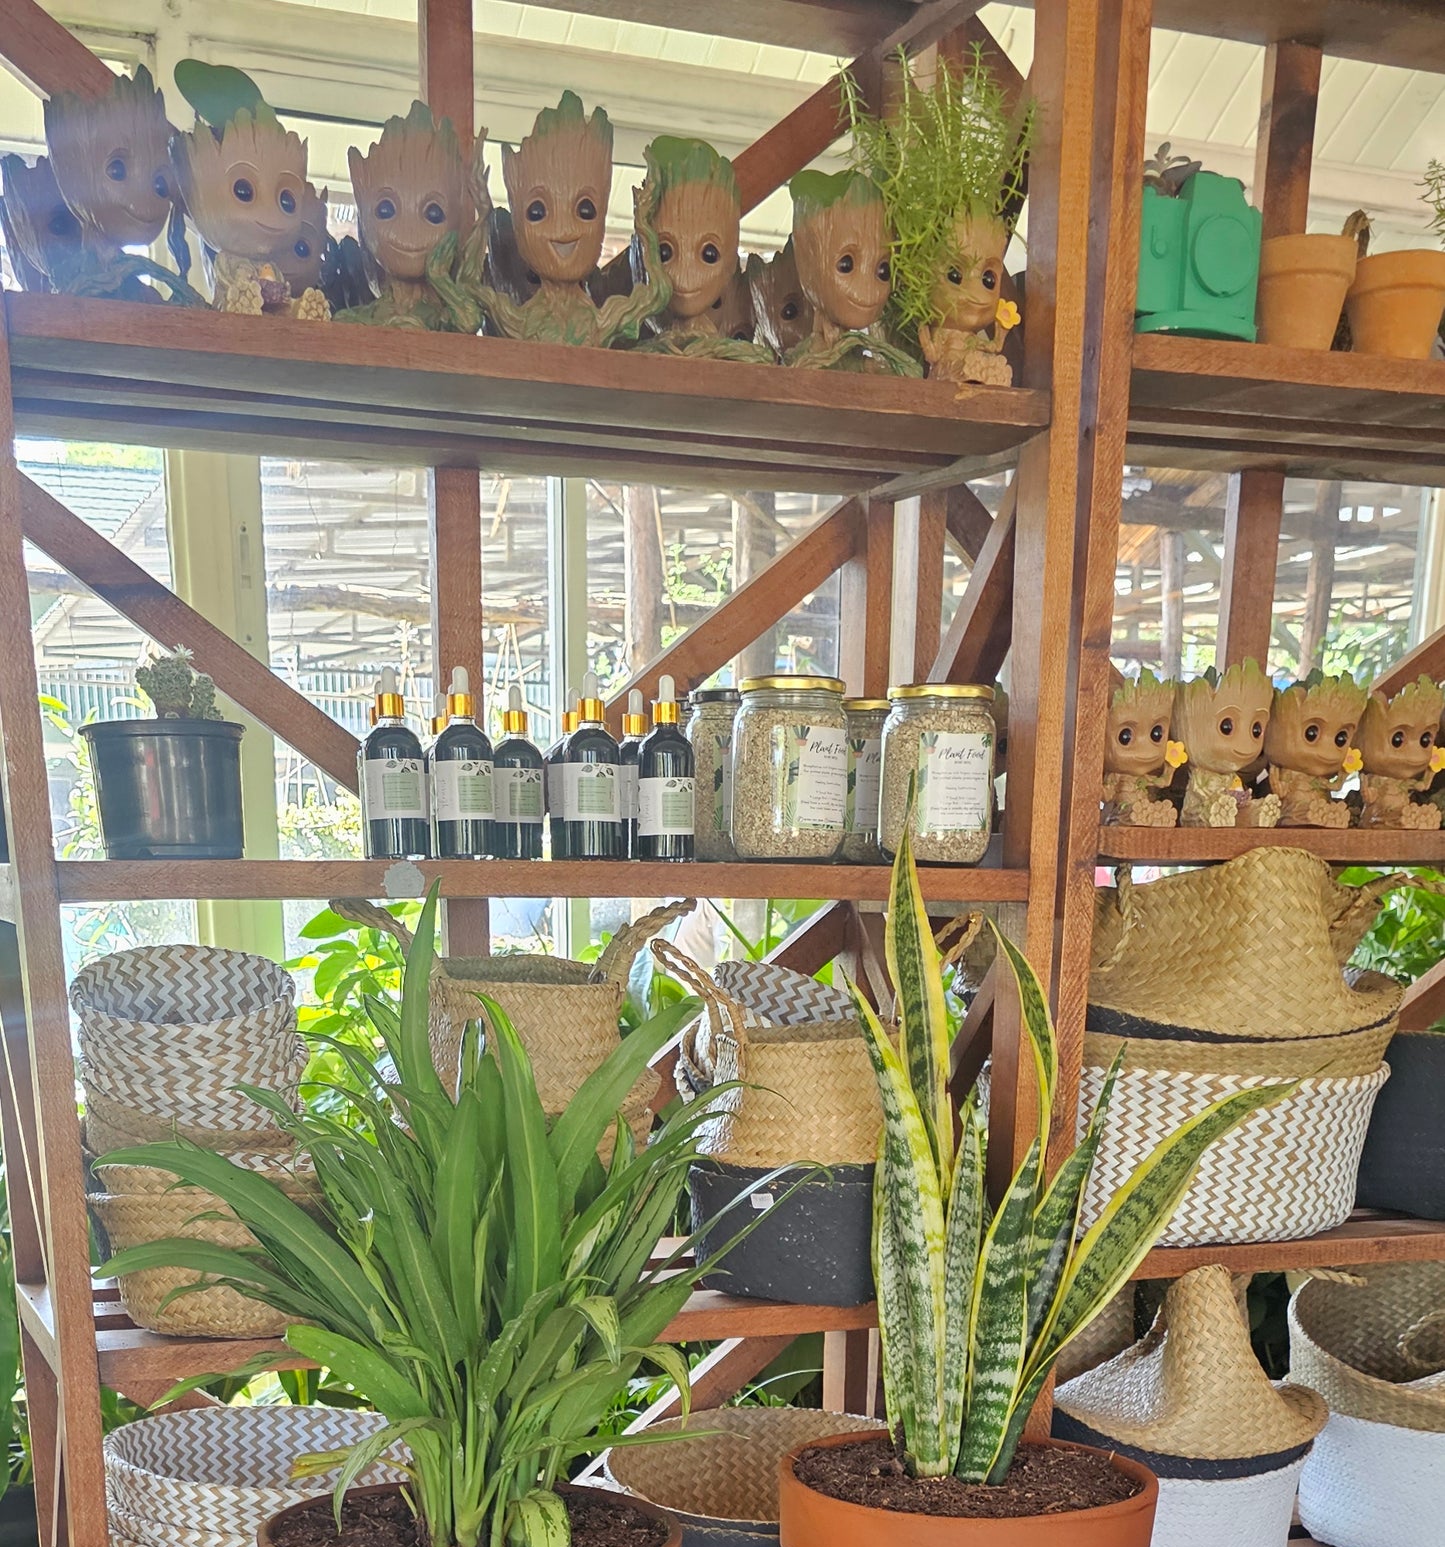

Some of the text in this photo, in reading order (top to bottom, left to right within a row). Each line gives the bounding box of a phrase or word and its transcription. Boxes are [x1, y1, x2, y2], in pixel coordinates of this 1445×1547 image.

[809, 740, 834, 754] Plant
[938, 746, 986, 760] Plant Food
